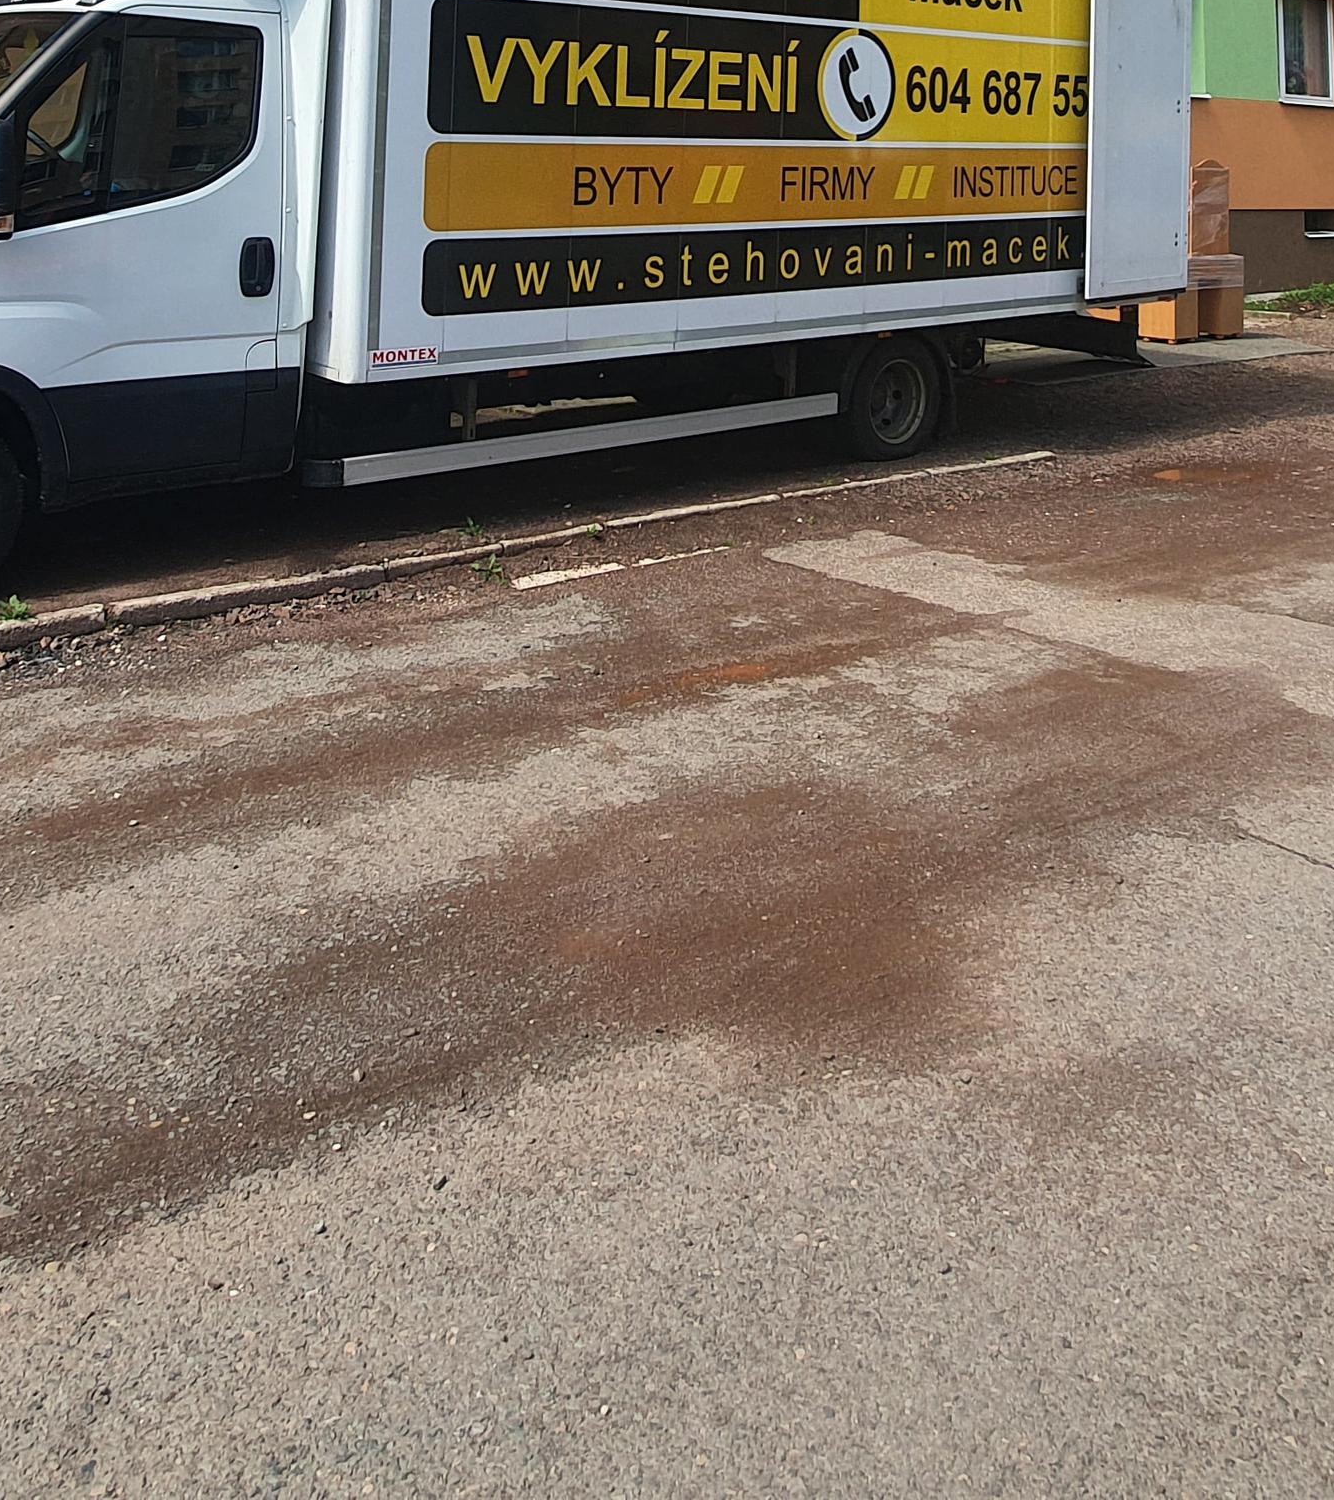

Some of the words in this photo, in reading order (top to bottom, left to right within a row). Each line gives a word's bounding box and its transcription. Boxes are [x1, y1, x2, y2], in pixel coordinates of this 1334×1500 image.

[467, 30, 800, 113] VYKLÍZENÍ
[907, 66, 970, 114] 604
[984, 70, 1042, 116] 687
[1053, 75, 1088, 117] 55
[574, 166, 673, 206] BYTY
[781, 167, 876, 202] FIRMY
[954, 165, 1079, 198] INSTITUCE
[372, 347, 437, 363] MONTEX
